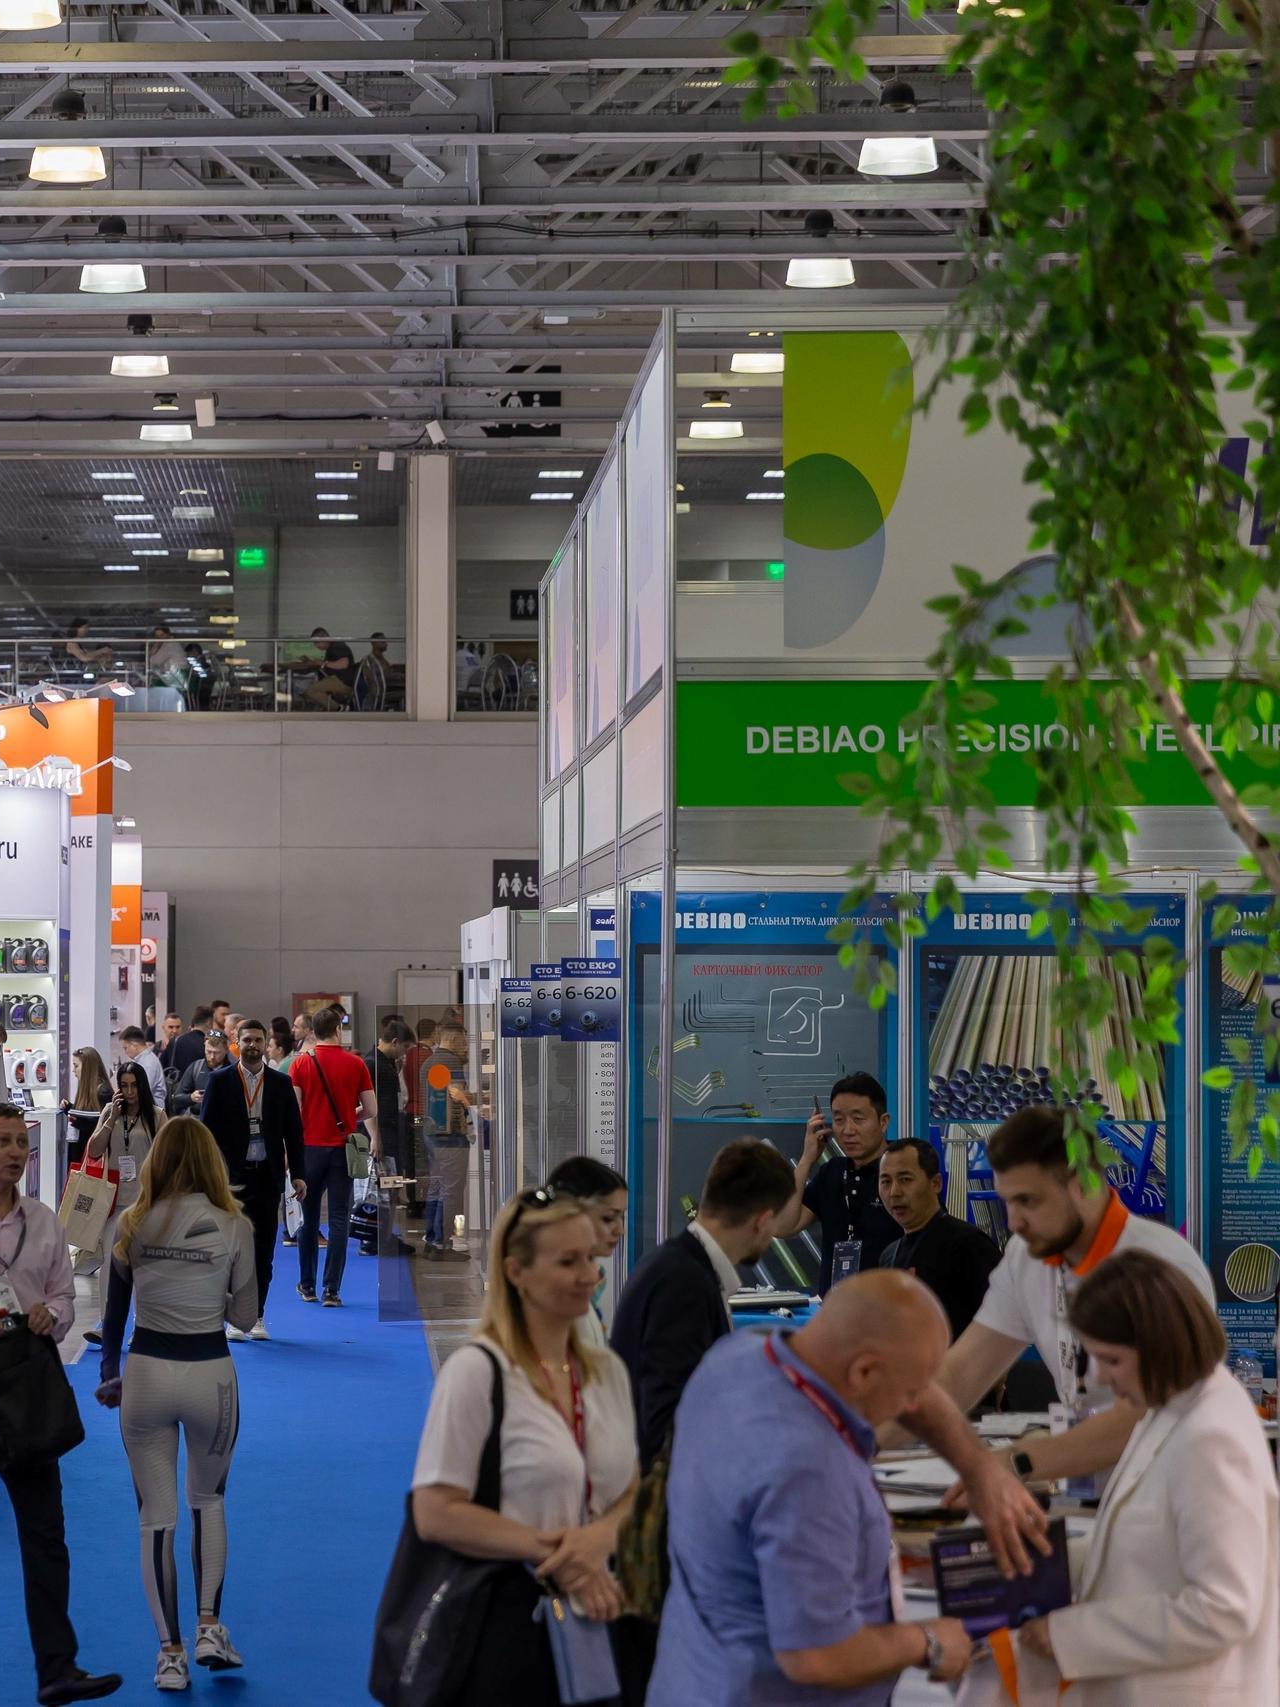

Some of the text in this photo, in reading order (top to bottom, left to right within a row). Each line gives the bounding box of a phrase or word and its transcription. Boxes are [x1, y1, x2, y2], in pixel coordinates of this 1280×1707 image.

[746, 724, 886, 754] DEBIAO
[748, 916, 790, 926] СТАЛЬНАЯ
[792, 917, 817, 926] ТРУБА
[953, 913, 1033, 930] DEBIAO
[693, 963, 824, 977] КАРТОЧНЫЙ ФИКСАТОР
[537, 988, 561, 1000] 6-6
[565, 986, 617, 1000] 6-620
